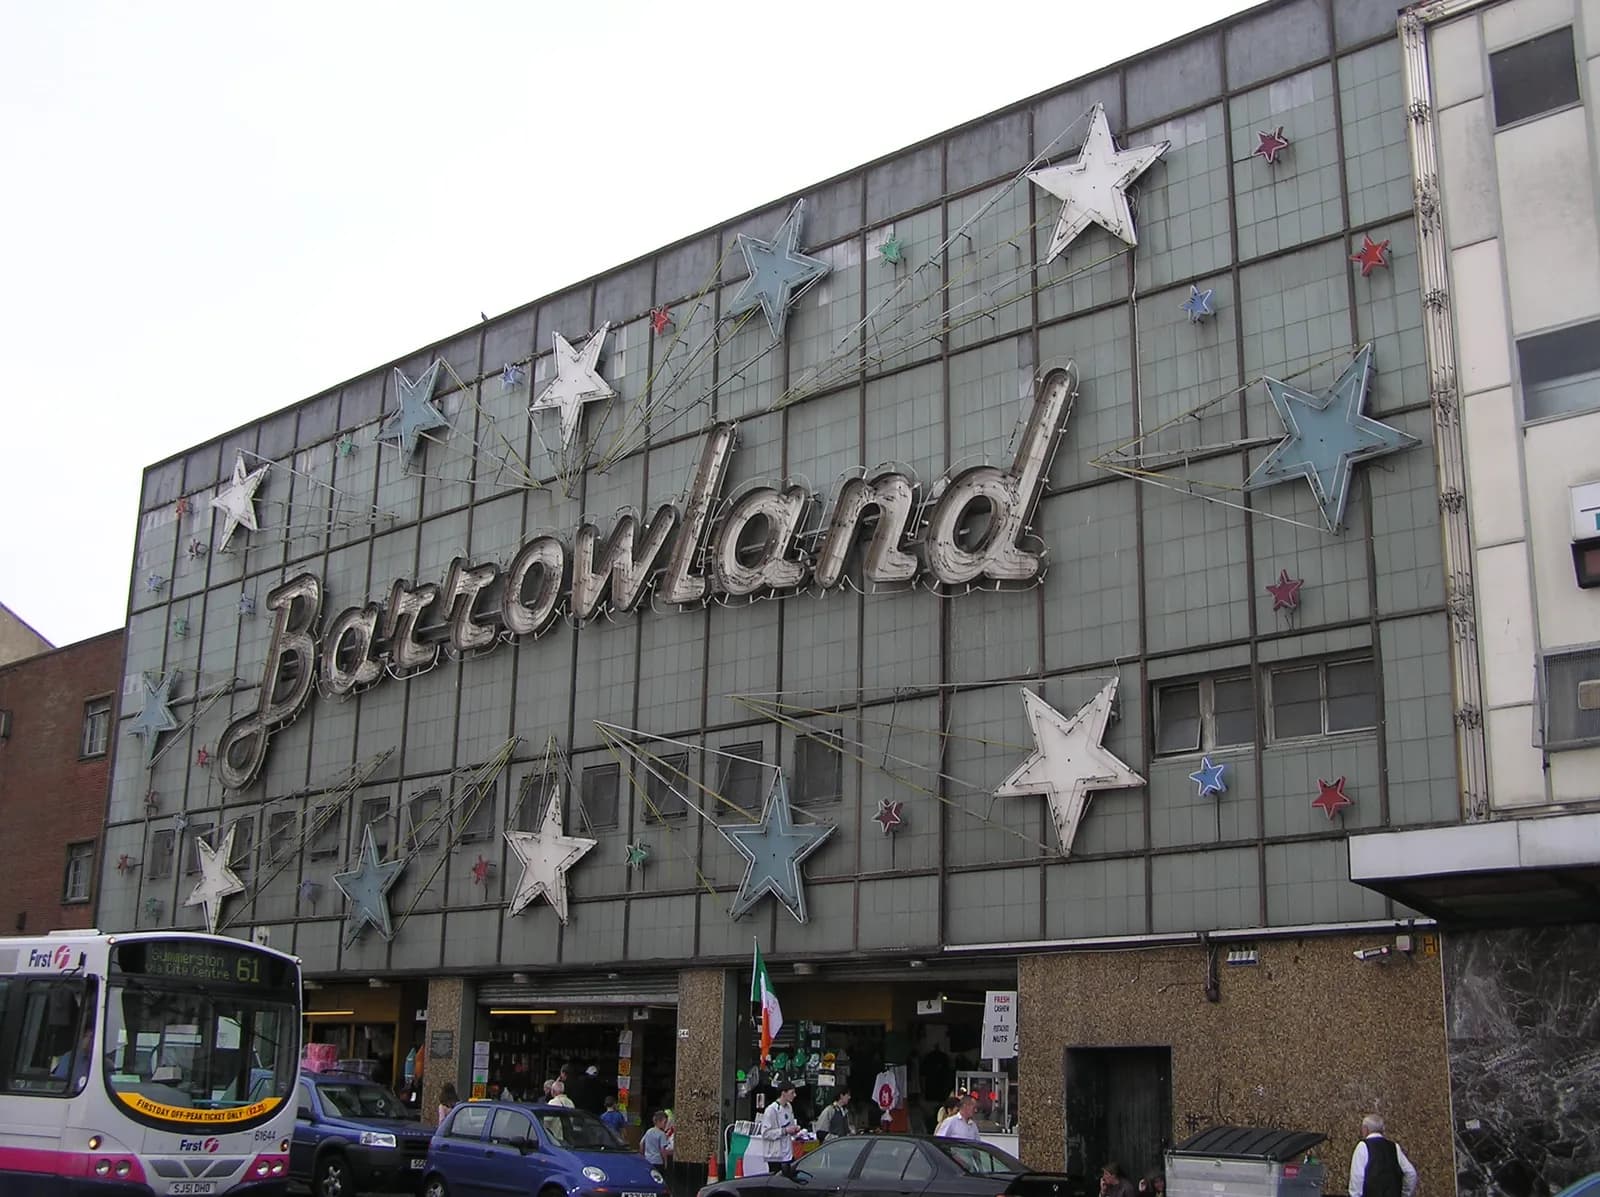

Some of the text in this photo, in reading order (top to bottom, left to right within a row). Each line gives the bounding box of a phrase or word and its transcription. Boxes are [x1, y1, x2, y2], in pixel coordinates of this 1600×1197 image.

[217, 364, 1079, 790] Barrowland
[29, 948, 53, 967] First
[237, 957, 260, 982] 61
[171, 1109, 202, 1121] OFF-PEAK
[204, 1111, 226, 1121] TICKET
[227, 1110, 243, 1120] ONLY
[254, 1130, 276, 1141] 61644
[179, 1139, 203, 1151] First
